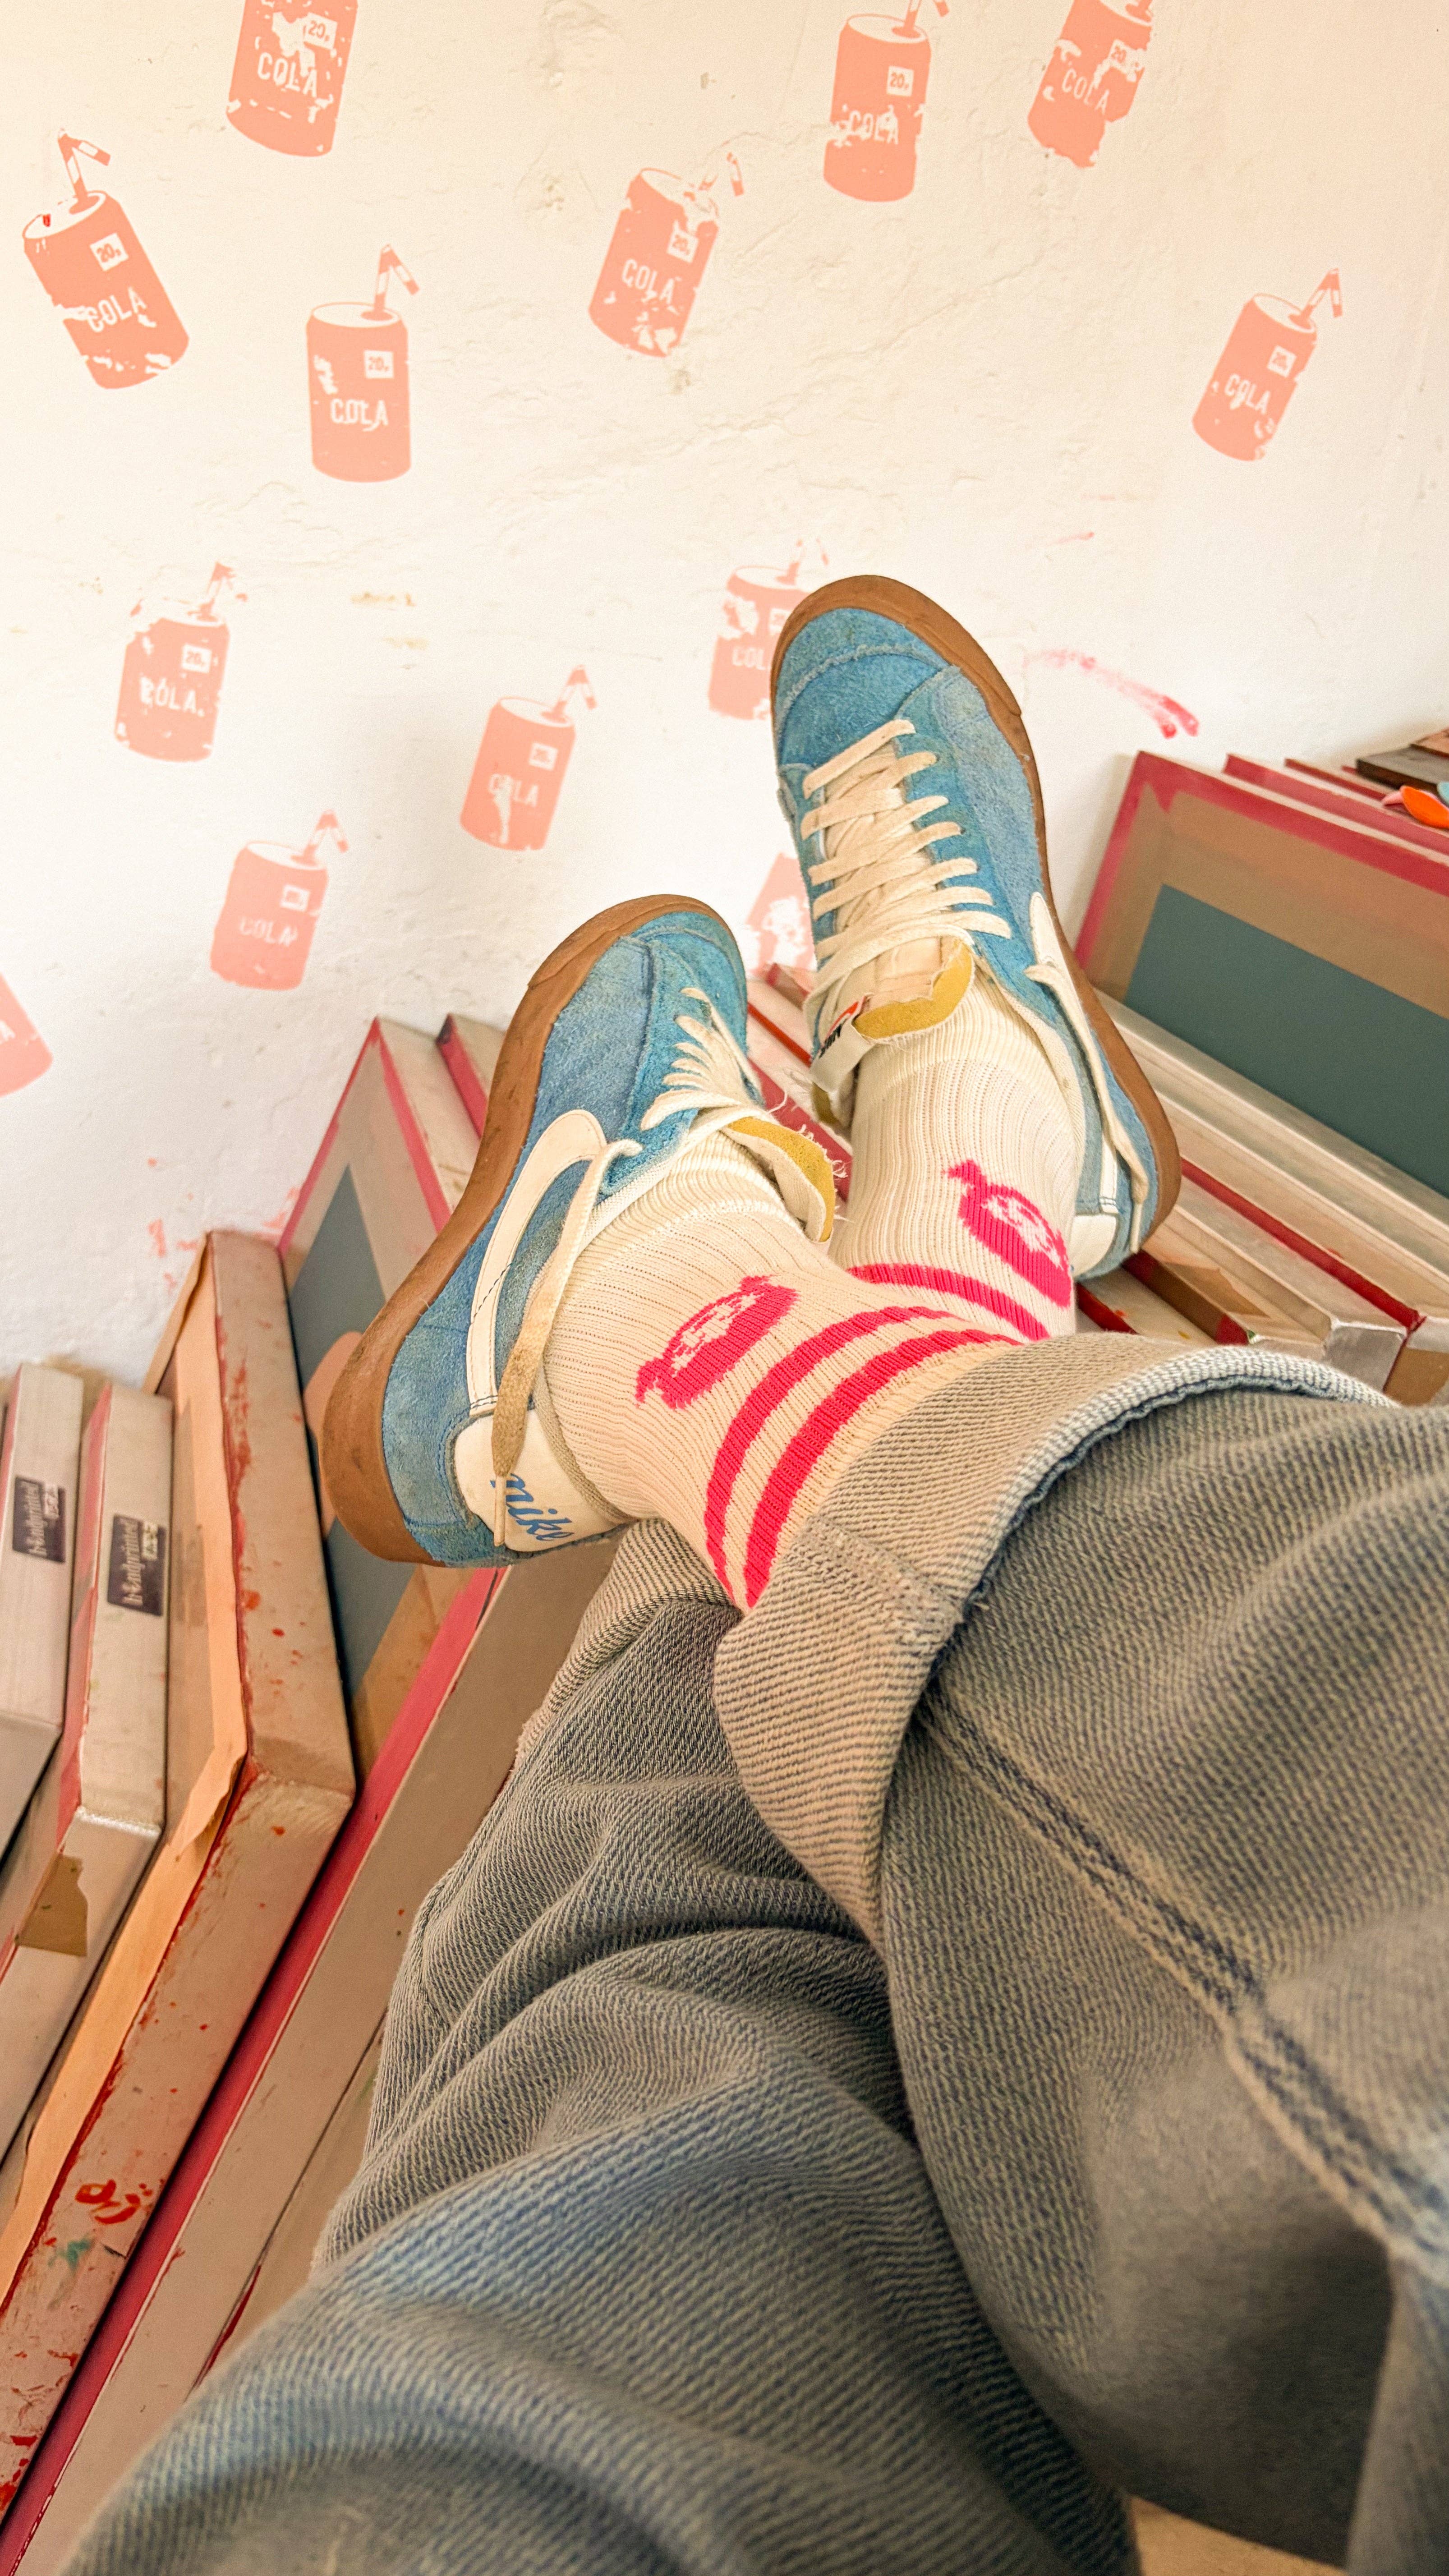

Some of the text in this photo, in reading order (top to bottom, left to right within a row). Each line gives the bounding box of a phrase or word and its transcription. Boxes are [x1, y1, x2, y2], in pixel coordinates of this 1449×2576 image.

[258, 52, 317, 97] COLA
[1062, 68, 1109, 115] COLA
[621, 258, 674, 304] COLA
[87, 286, 147, 332] COLA
[331, 398, 389, 425] COLA
[1224, 373, 1270, 414] COLA
